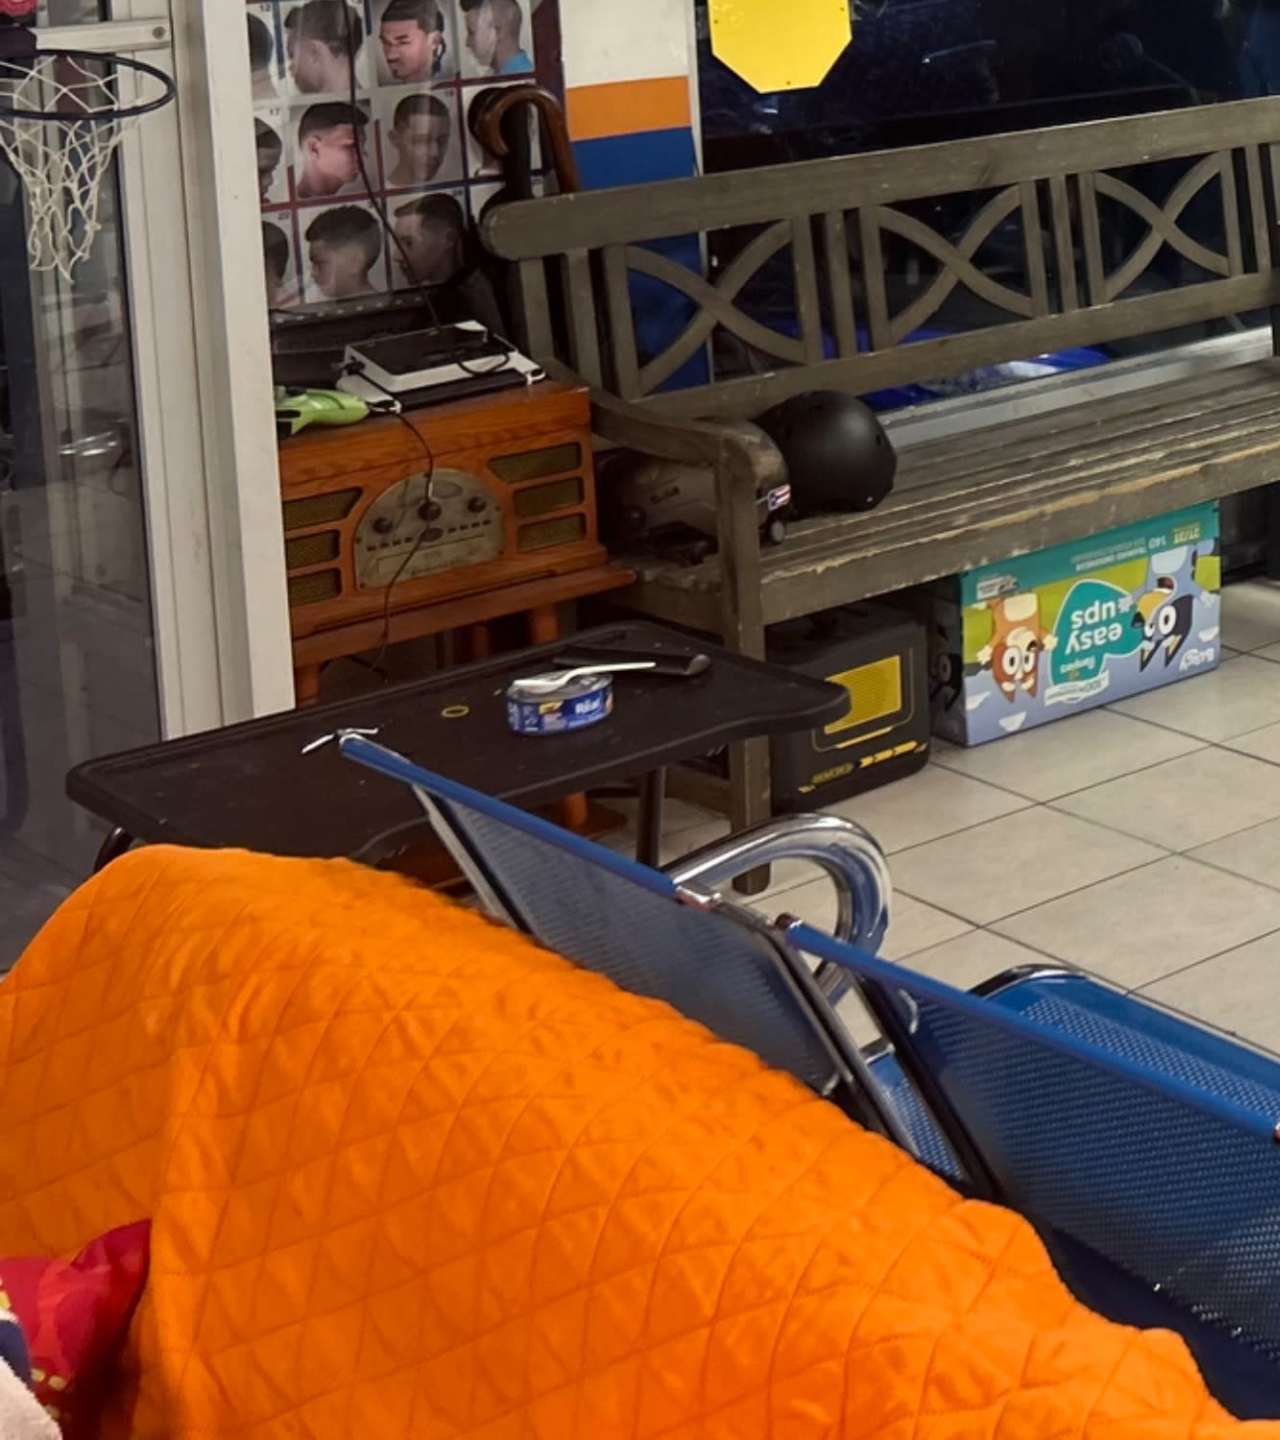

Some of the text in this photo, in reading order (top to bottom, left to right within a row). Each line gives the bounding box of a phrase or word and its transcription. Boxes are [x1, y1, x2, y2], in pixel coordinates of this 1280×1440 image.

[1071, 599, 1116, 629] ups
[1065, 622, 1123, 655] easy
[1060, 655, 1095, 674] Pampers
